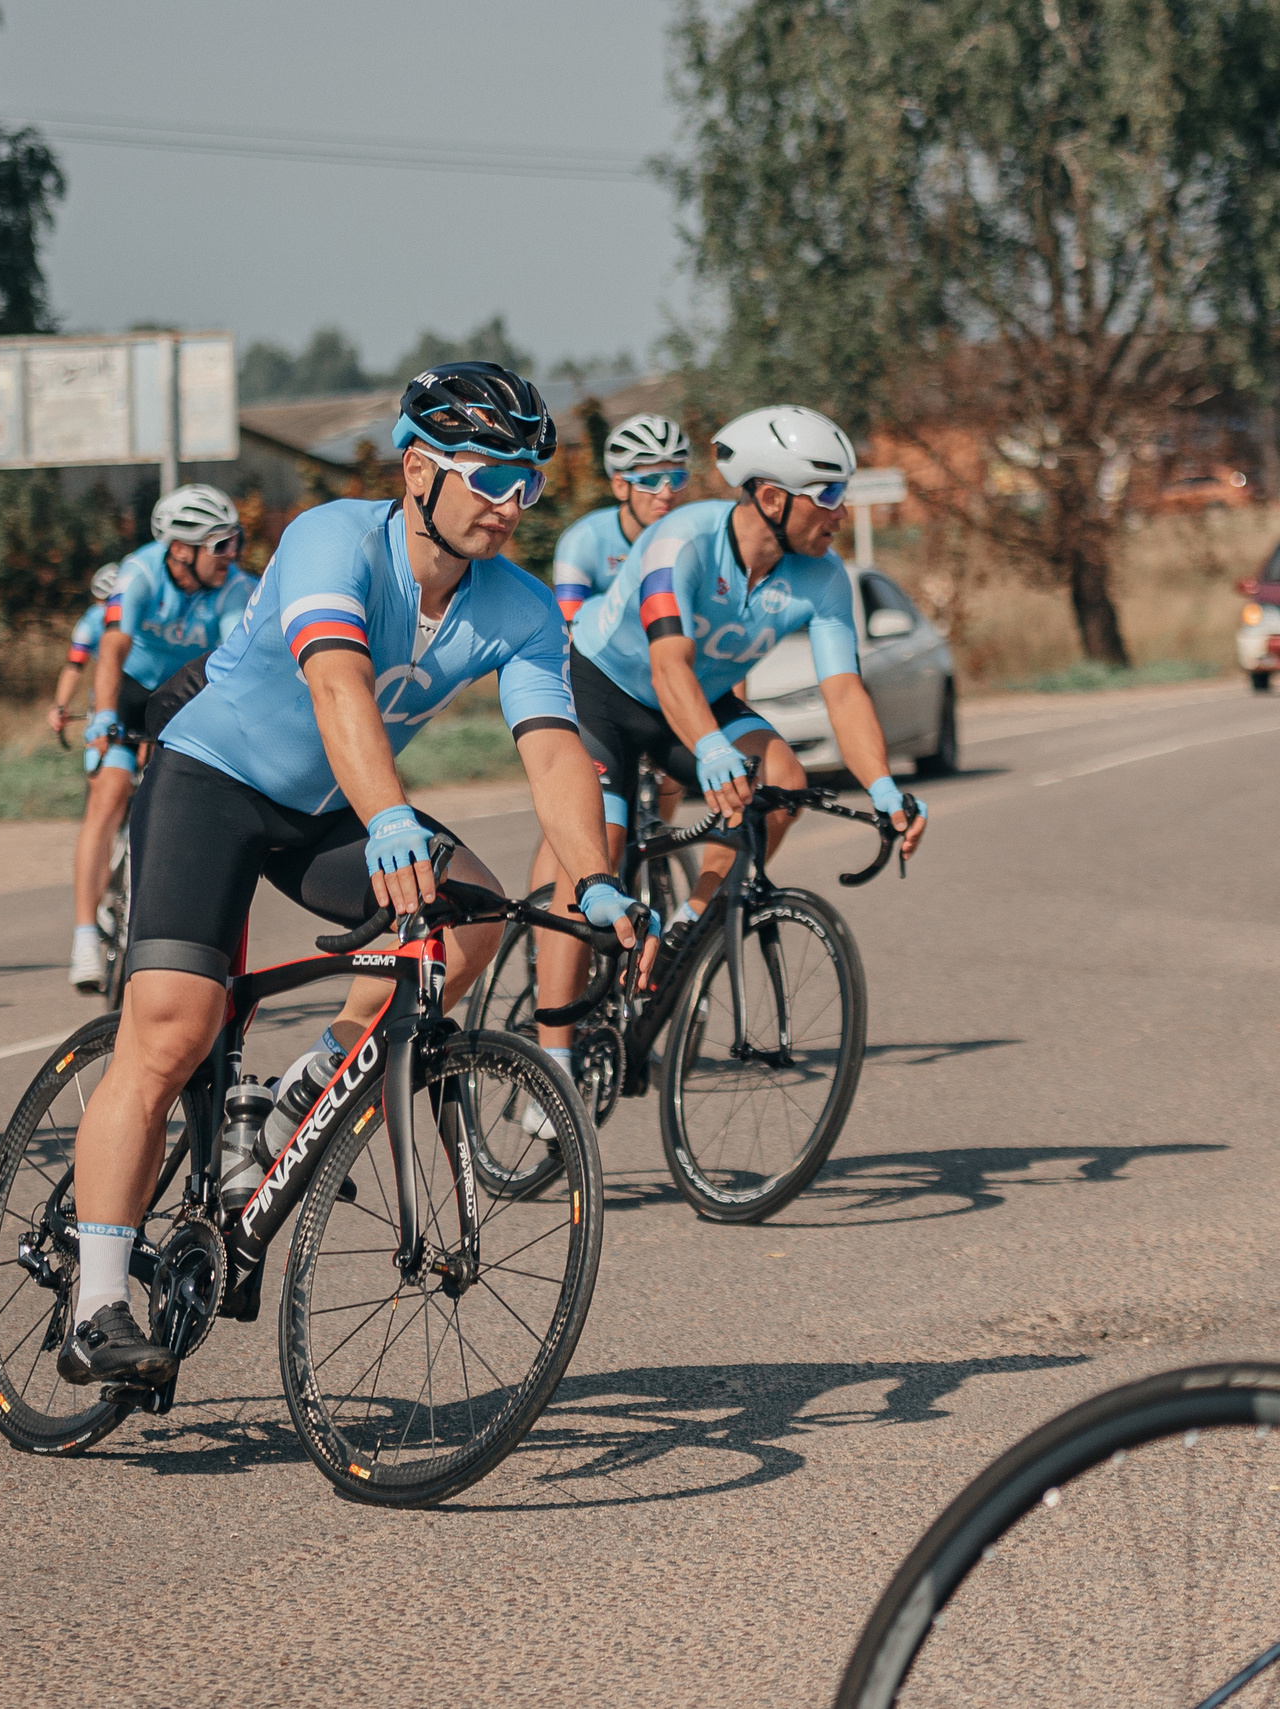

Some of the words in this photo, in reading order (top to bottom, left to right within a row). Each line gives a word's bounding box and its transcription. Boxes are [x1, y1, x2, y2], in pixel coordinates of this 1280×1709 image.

[352, 954, 397, 967] DOGMA
[241, 1035, 379, 1238] PINARELLO
[87, 1225, 118, 1236] RCA
